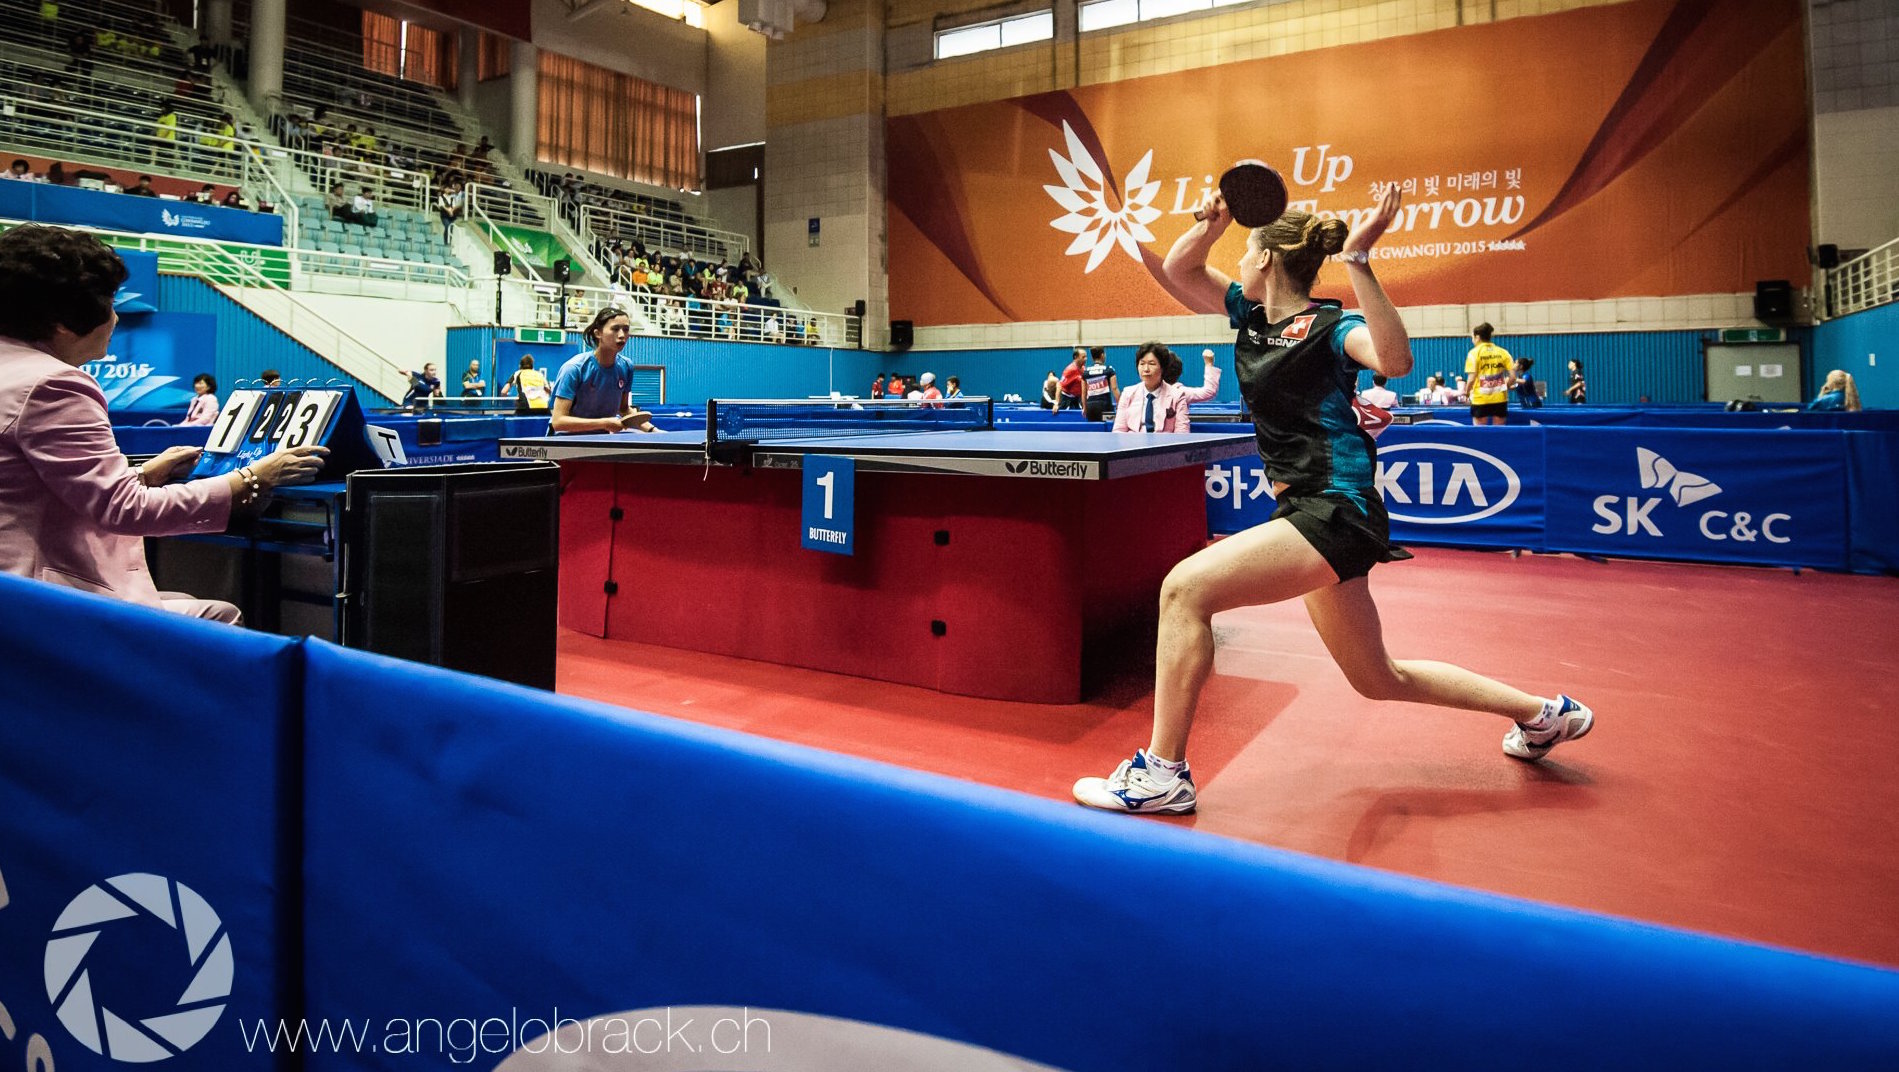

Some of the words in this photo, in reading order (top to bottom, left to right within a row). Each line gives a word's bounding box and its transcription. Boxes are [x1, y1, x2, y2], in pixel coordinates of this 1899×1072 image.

[1293, 144, 1353, 192] Up
[1368, 177, 1416, 201] 창의
[1424, 175, 1440, 197] 빛
[1447, 170, 1497, 192] 미래의
[1505, 168, 1521, 190] 빛
[1380, 243, 1451, 260] GWANGJU
[1453, 240, 1486, 255] 2015
[1267, 337, 1300, 348] DON
[104, 363, 150, 379] 2015
[218, 402, 244, 448] 1
[253, 403, 275, 439] 2
[272, 403, 293, 439] 2
[286, 403, 319, 449] 3
[377, 431, 397, 459] T
[518, 447, 548, 459] Butterfly
[408, 455, 453, 465] IVERSIADE
[1030, 460, 1088, 479] Butterfly
[816, 471, 834, 520] 1
[1374, 461, 1489, 506] KIA
[1591, 495, 1664, 537] SK
[1700, 510, 1792, 544] C&C
[808, 526, 847, 545] BUTTERFLY
